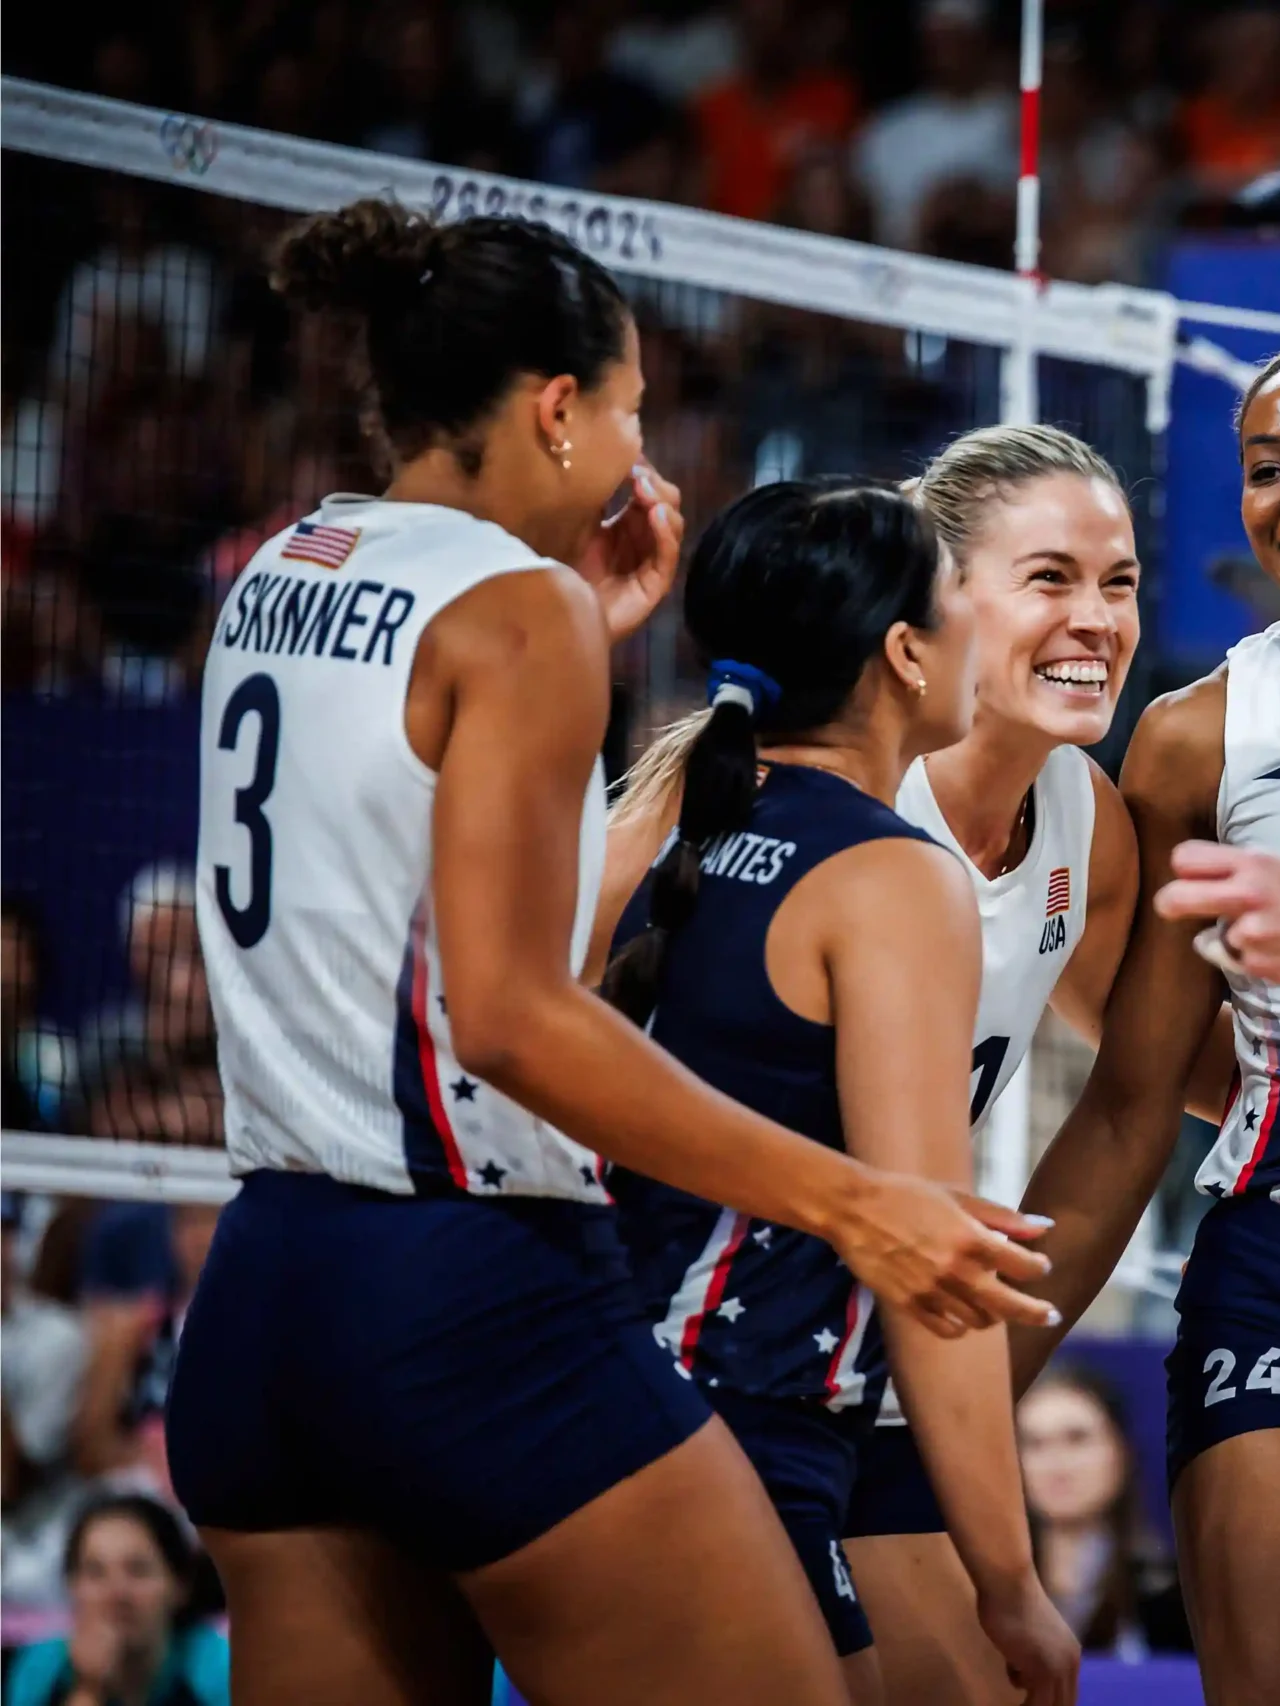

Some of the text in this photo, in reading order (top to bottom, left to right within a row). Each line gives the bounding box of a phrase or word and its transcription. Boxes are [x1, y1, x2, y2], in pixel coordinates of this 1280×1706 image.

[561, 201, 663, 261] 2024
[224, 572, 416, 666] SKINNER
[214, 672, 281, 949] 3
[1038, 915, 1066, 955] USA
[829, 1540, 856, 1602] 4
